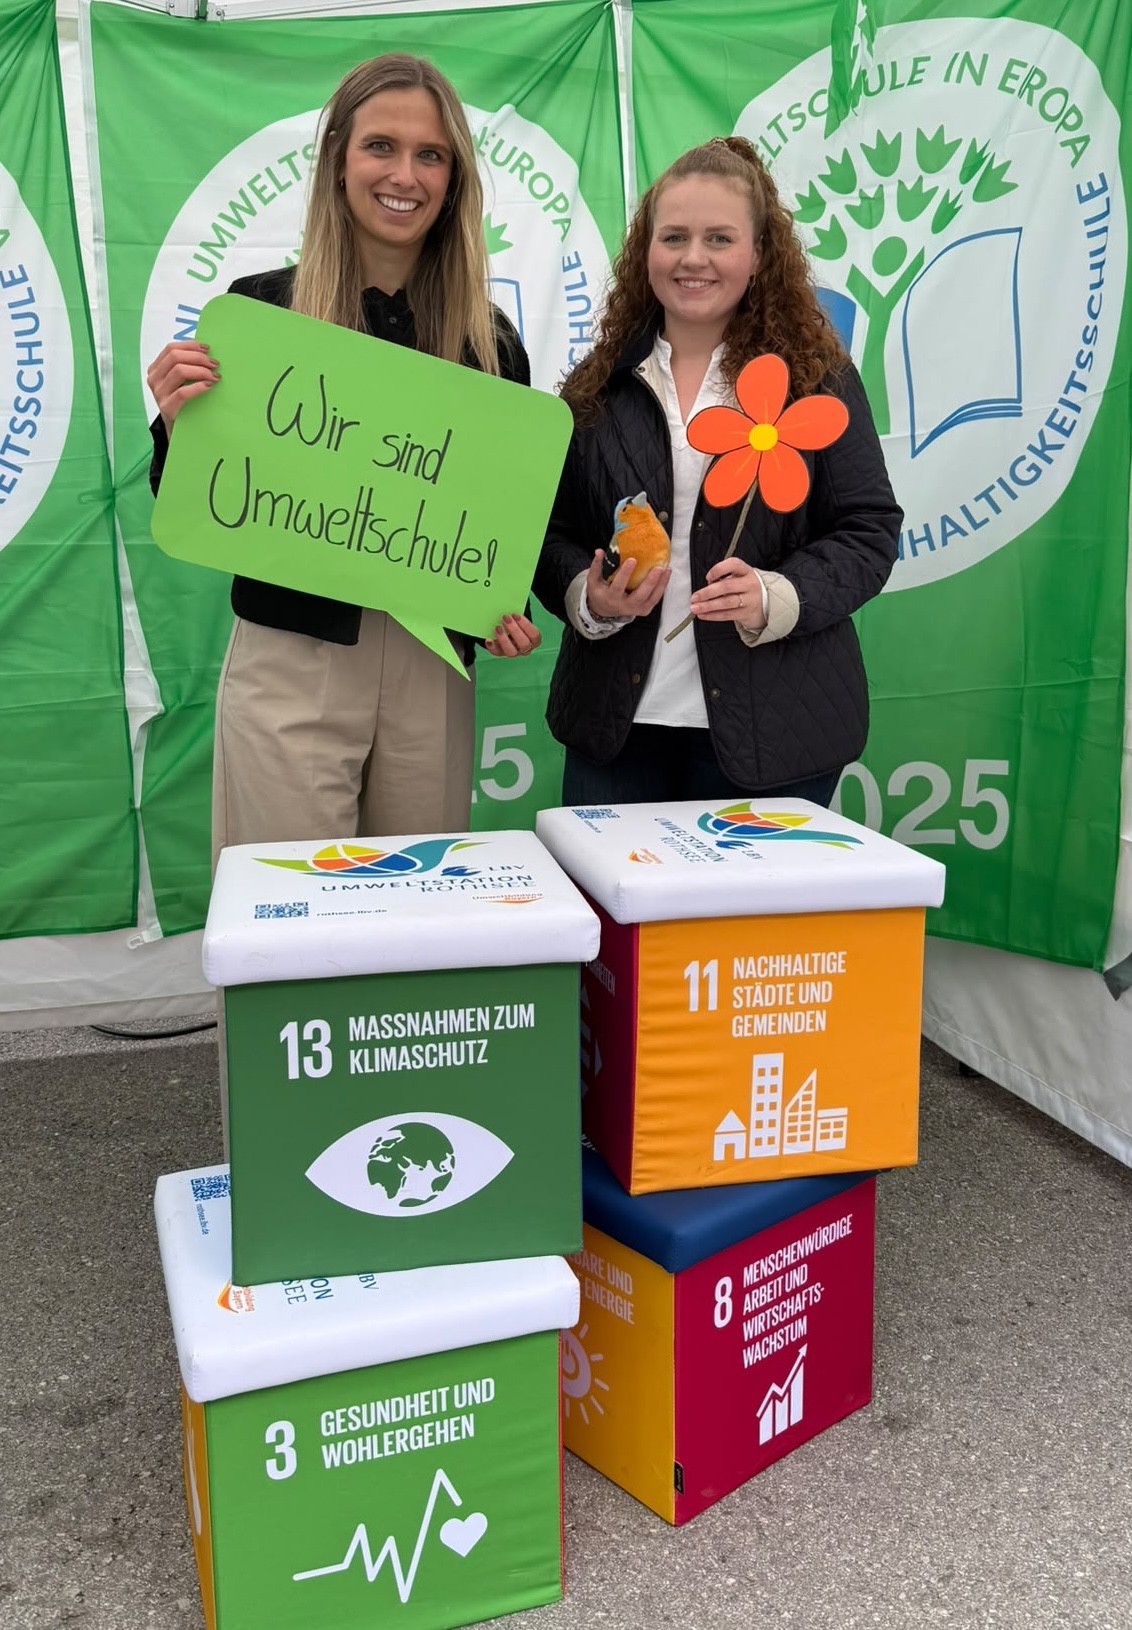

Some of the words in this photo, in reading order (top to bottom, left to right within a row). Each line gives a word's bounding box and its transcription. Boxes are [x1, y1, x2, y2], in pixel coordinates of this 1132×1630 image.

[755, 56, 931, 168] LTSCULE
[944, 51, 989, 86] IN
[997, 58, 1091, 169] EROPA
[0, 263, 44, 504] EITSSCHULE
[897, 172, 1110, 561] HALTIGKEITSSCHULE
[266, 365, 360, 452] Wir
[371, 428, 453, 485] sind
[208, 456, 498, 588] Umweltschule!
[828, 759, 1010, 850] 025
[321, 874, 534, 892] UMWELTSTATION
[421, 880, 537, 893] ROTHSEE
[488, 864, 525, 872] LBV
[683, 959, 719, 1012] 11
[732, 951, 847, 980] NACHHALTIGE
[732, 981, 794, 1009] STÄDTE
[799, 980, 833, 1005] UND
[348, 1006, 490, 1042] MASSNAHMEN
[494, 1003, 535, 1031] ZUM
[731, 1010, 827, 1038] GEMEINDEN
[279, 1019, 333, 1080] 13
[349, 1039, 488, 1075] KLIMASCHUTZ
[743, 1214, 853, 1288] MENSCHENWÜRDIGE
[584, 1276, 635, 1325] ENERGIE
[606, 1262, 633, 1296] UND
[713, 1276, 732, 1329] 8
[743, 1275, 783, 1316] ARBEIT
[784, 1264, 808, 1294] UND
[743, 1283, 825, 1342] WIRTSCHAFTS-
[742, 1316, 808, 1369] WACHSTUM
[320, 1388, 451, 1437] GESUNDHEIT
[453, 1377, 496, 1410] UND
[264, 1420, 298, 1481] 3
[321, 1413, 475, 1470] WOHLERGEHEN
